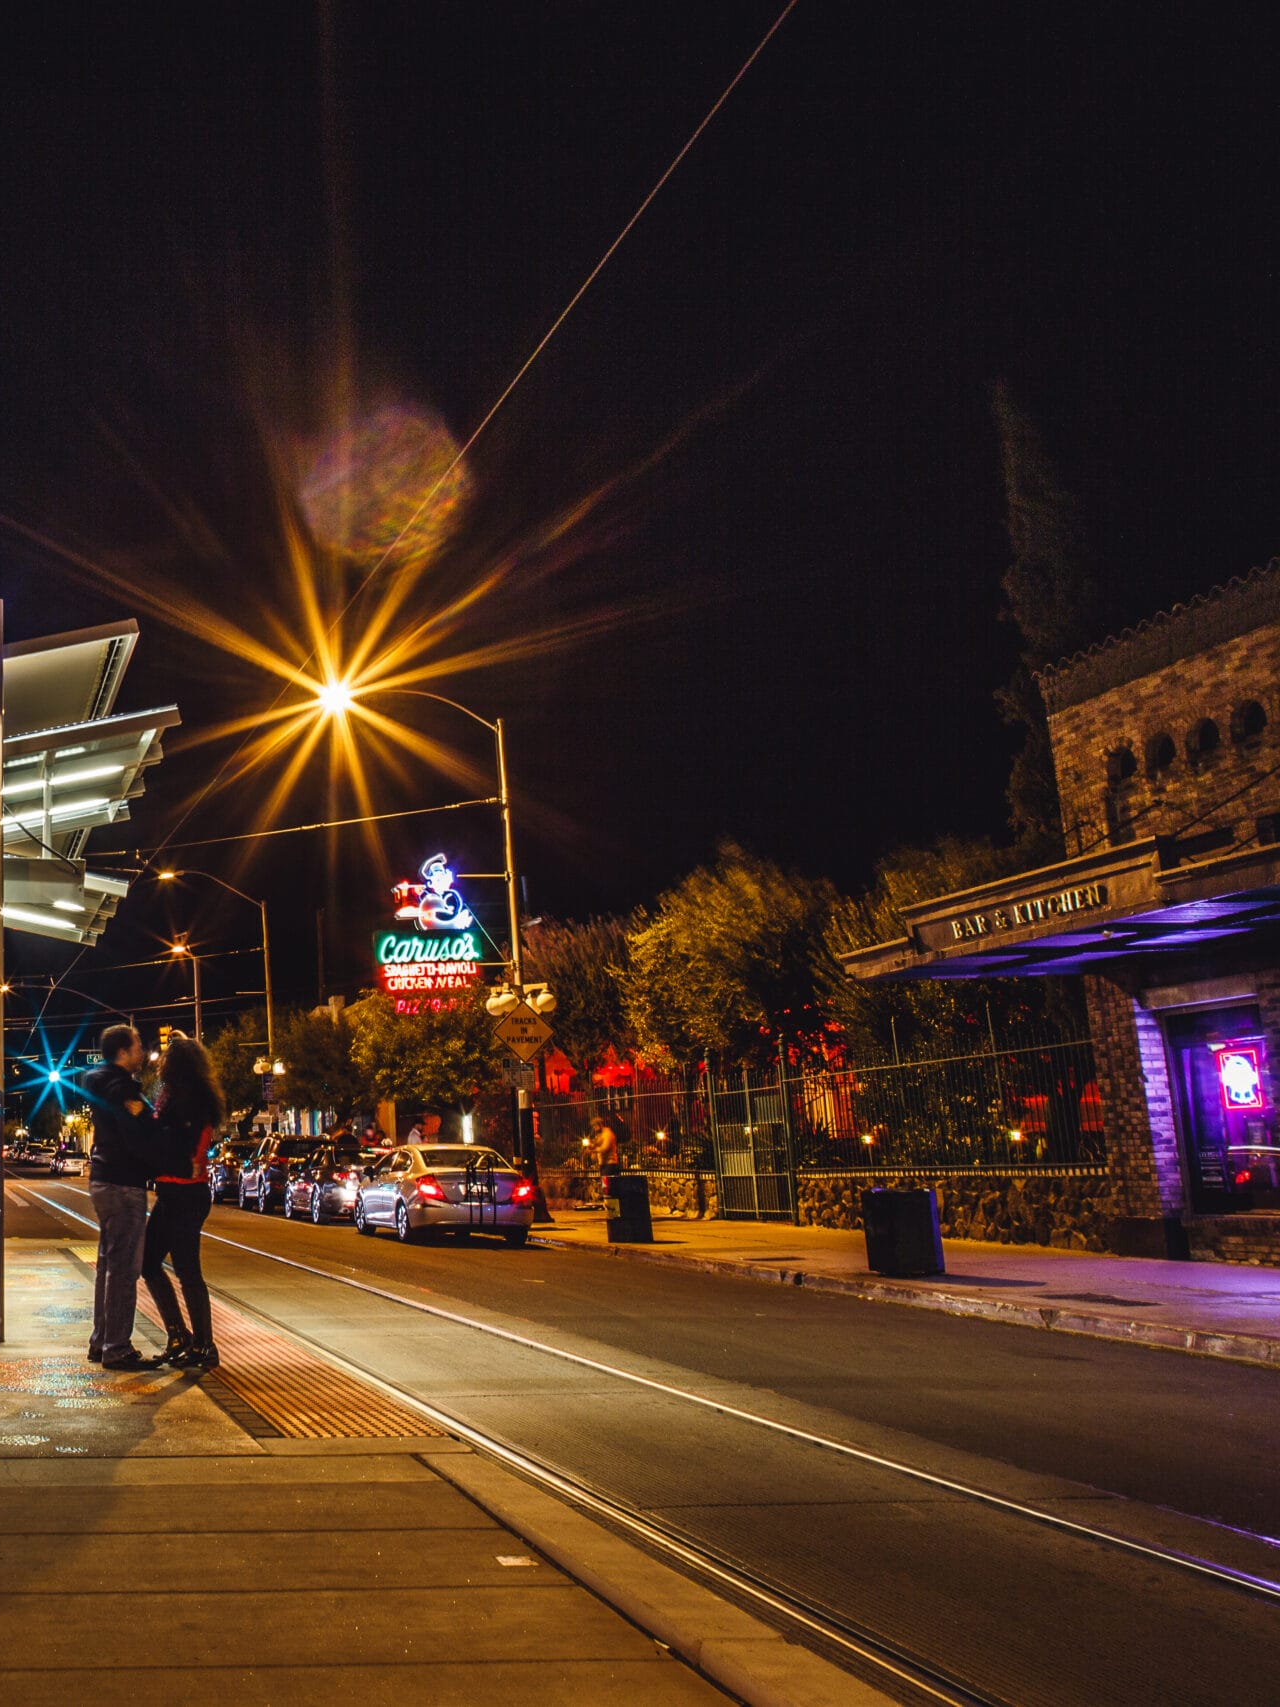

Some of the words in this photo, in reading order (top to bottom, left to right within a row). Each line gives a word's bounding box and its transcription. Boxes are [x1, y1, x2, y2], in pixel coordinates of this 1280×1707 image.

[951, 913, 987, 939] BAR
[995, 909, 1008, 929] &
[1013, 884, 1102, 924] KITCHEN
[380, 932, 480, 963] Caruso's
[511, 1017, 537, 1025] TRACKS
[520, 1026, 528, 1034] IN
[506, 1035, 542, 1043] PAVEMENT
